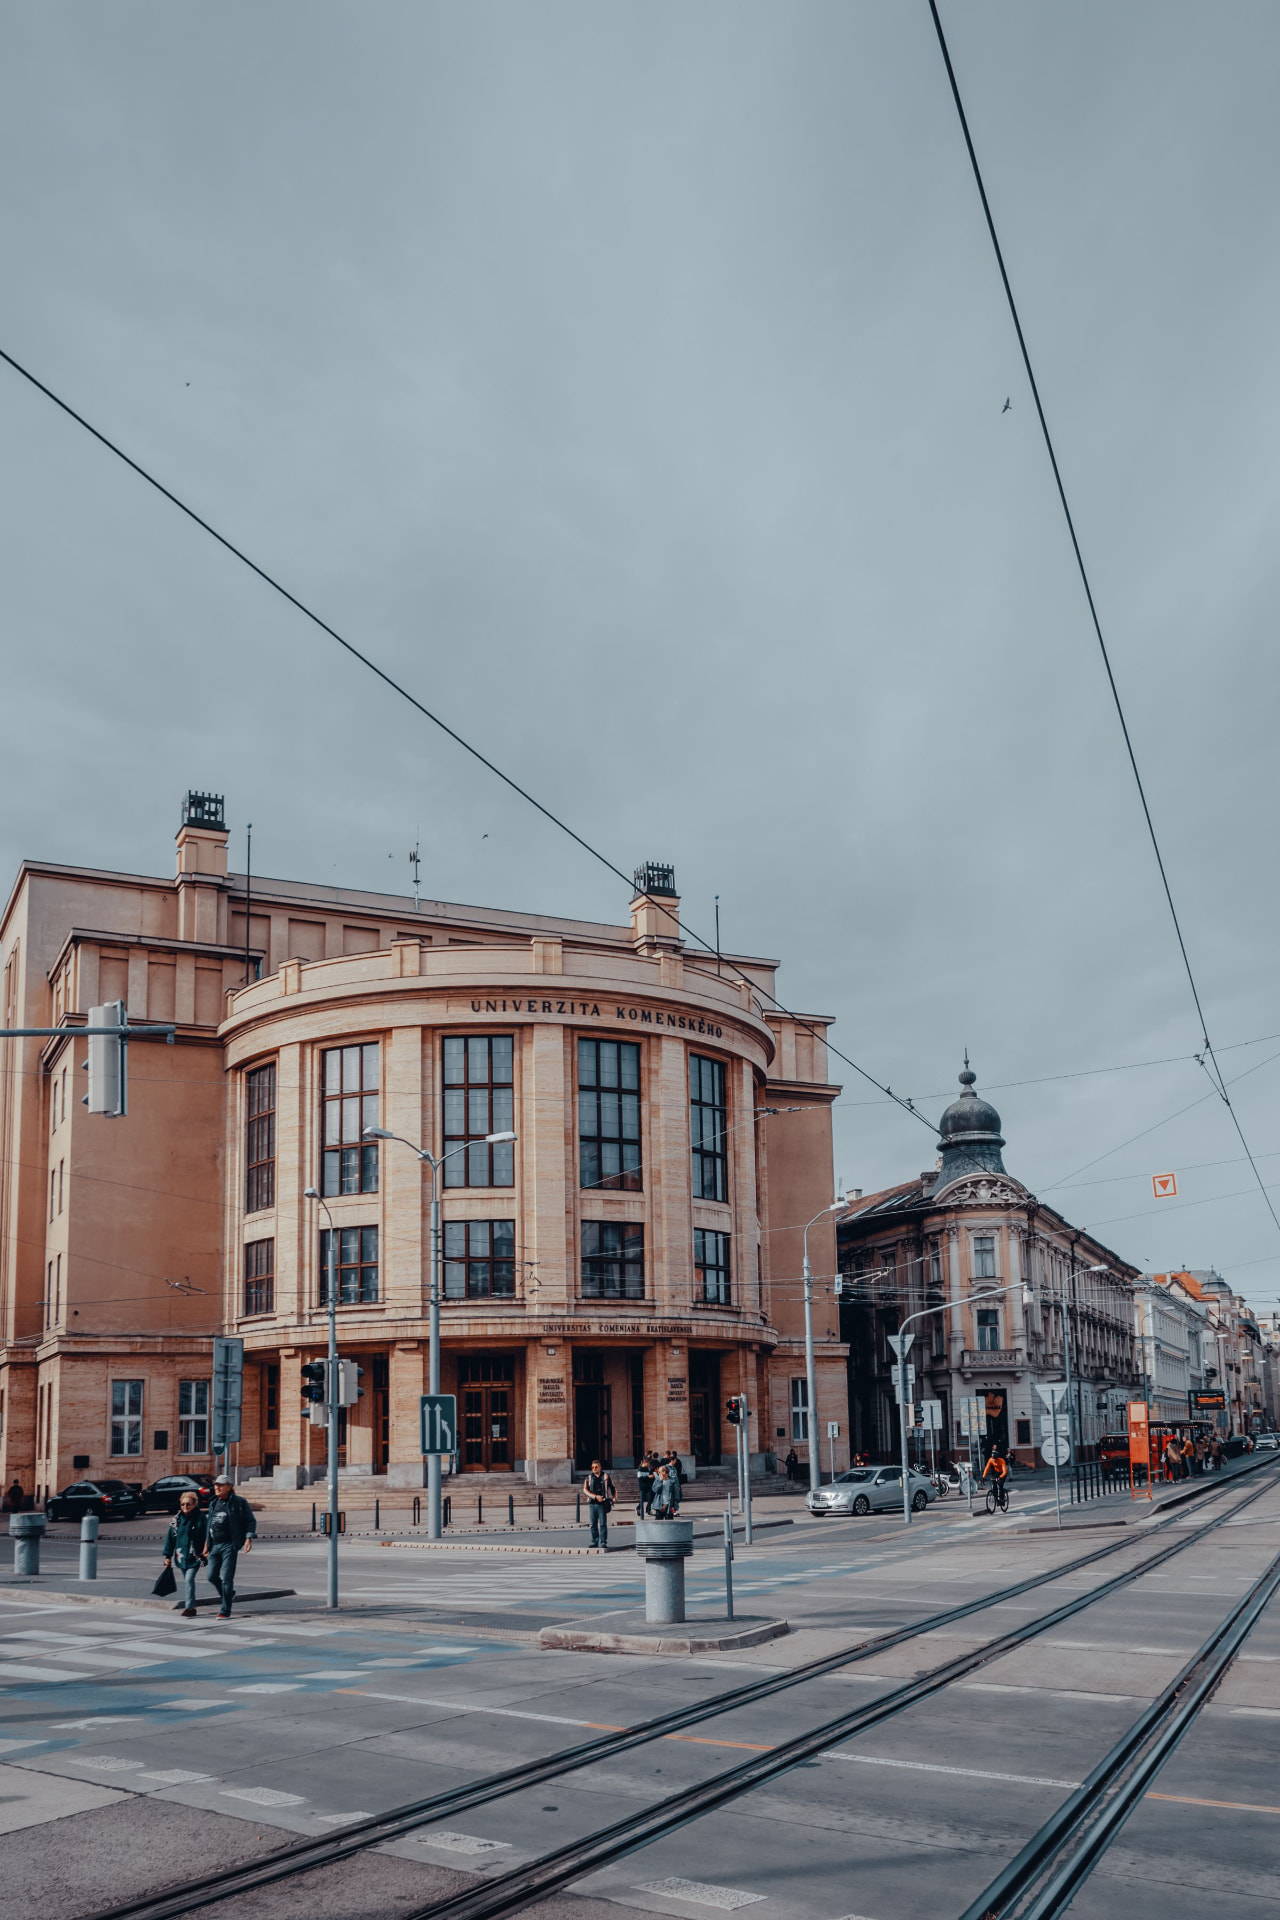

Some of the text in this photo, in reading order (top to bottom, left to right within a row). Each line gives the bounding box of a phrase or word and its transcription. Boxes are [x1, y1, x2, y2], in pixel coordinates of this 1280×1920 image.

[470, 999, 723, 1039] UNIVERZITA KOMENSKÉHO
[543, 1324, 693, 1334] UNIVERSITAS COMENIANA BRATISLAVENSIS
